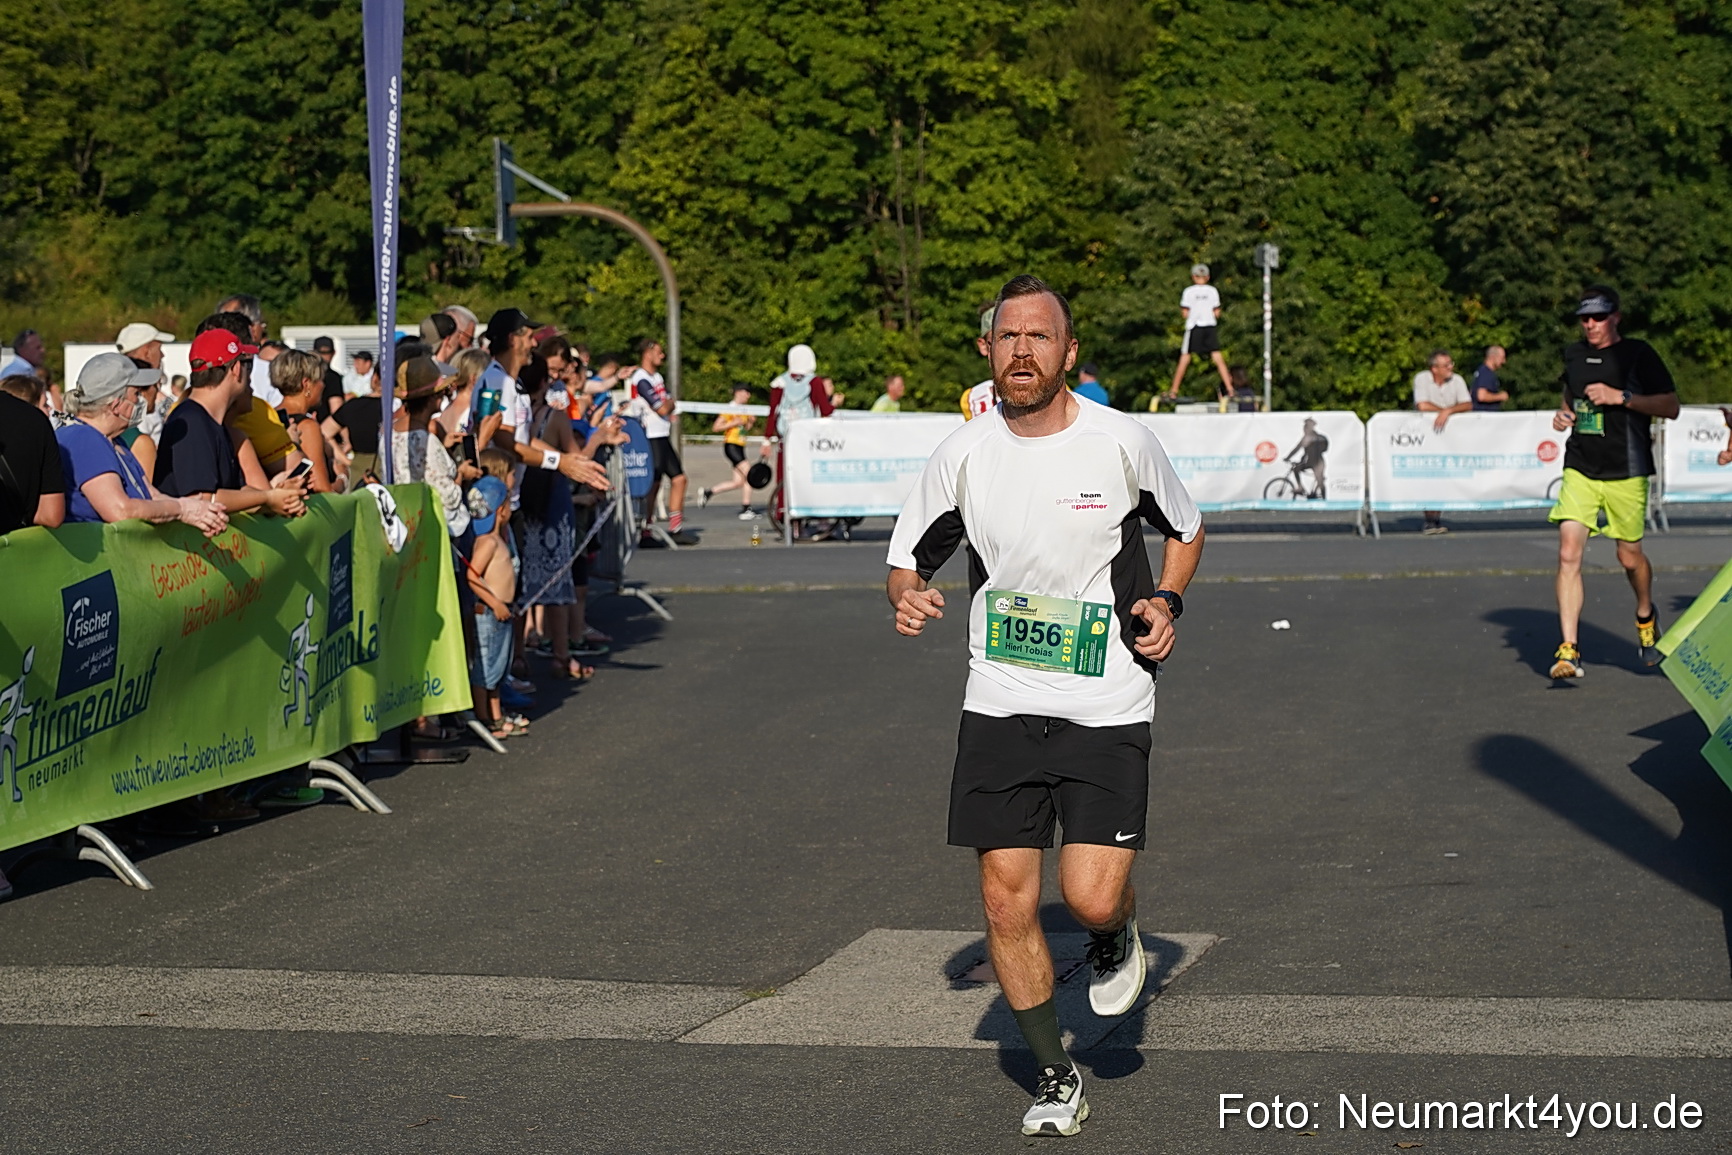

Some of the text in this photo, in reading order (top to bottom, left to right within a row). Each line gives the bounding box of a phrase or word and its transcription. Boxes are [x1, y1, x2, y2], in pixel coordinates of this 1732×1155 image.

[810, 439, 845, 451] NOW
[1391, 433, 1425, 447] NOW
[74, 609, 112, 640] Fischer
[991, 622, 1000, 647] RUN
[1002, 616, 1063, 647] 1956
[77, 629, 109, 650] AUTOMOBILE
[1005, 642, 1053, 657] Hierl Tobias
[1061, 629, 1074, 663] 2022
[27, 646, 162, 765] firmenlauf
[28, 747, 85, 792] neumarkt
